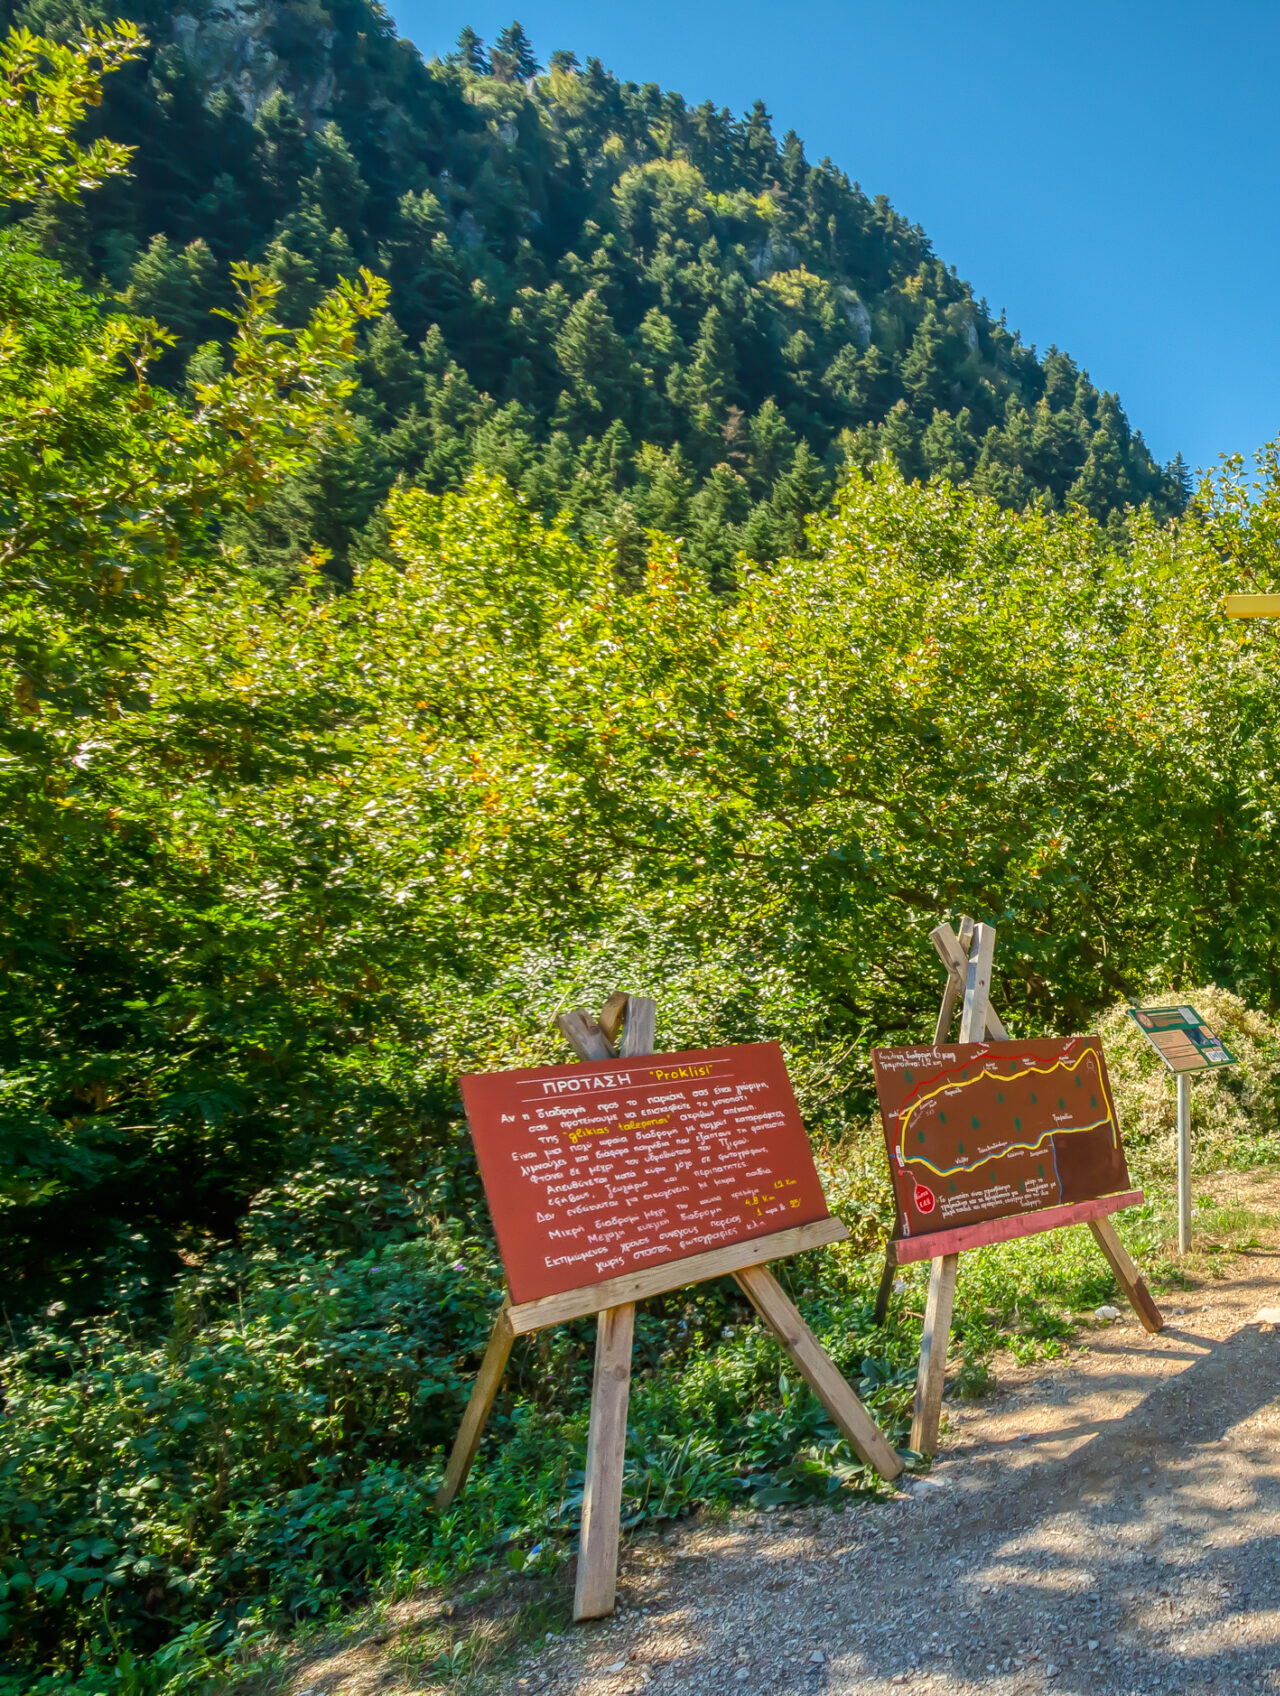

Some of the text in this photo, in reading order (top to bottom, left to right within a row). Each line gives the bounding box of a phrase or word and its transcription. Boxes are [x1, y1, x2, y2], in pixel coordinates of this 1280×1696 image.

[543, 1073, 631, 1094] ΠΡΟΤΑΣΗ
[501, 1114, 515, 1124] Αν
[522, 1113, 530, 1121] η
[536, 1106, 586, 1119] διαδρομή
[692, 1088, 709, 1098] σας
[528, 1124, 549, 1133] σας
[560, 1114, 618, 1129] προτείνουμε
[538, 1135, 559, 1144] της
[544, 1147, 562, 1160] μια
